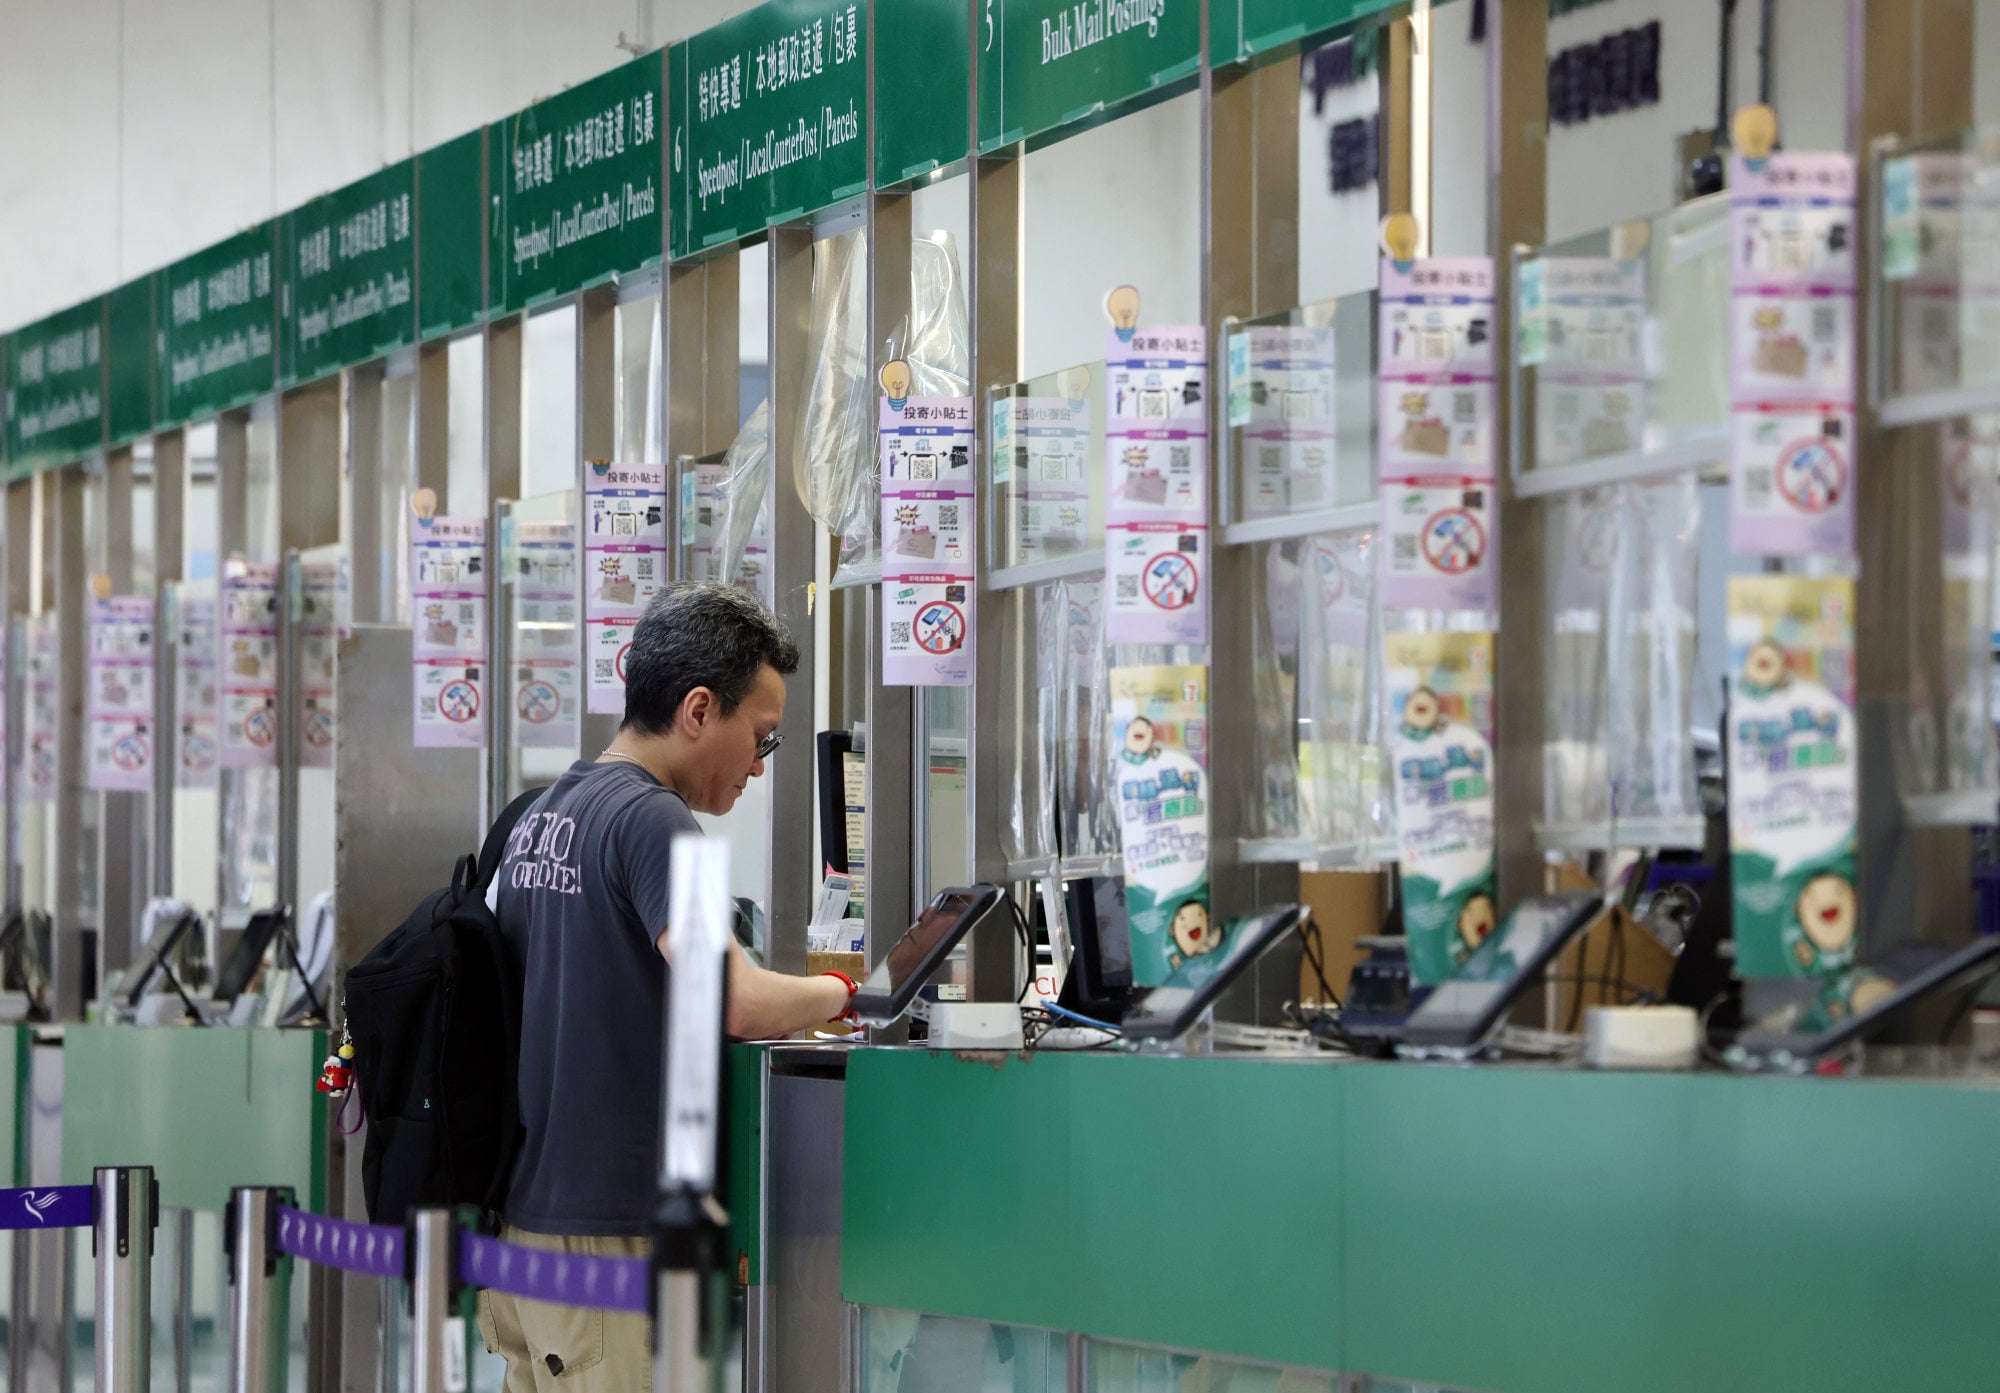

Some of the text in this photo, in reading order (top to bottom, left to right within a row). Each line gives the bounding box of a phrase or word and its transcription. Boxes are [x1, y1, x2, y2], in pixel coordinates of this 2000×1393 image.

[1041, 0, 1165, 65] Bulk Mail Postings
[699, 54, 741, 123] 特快專遞
[755, 17, 823, 98] 本地郵政速遞
[674, 126, 682, 173] 6
[698, 151, 739, 212] Speedpost
[746, 117, 818, 180] LocalCourierPost
[826, 97, 858, 149] Parcels
[904, 407, 968, 420] 投寄小貼士
[607, 472, 661, 484] 投寄小貼士
